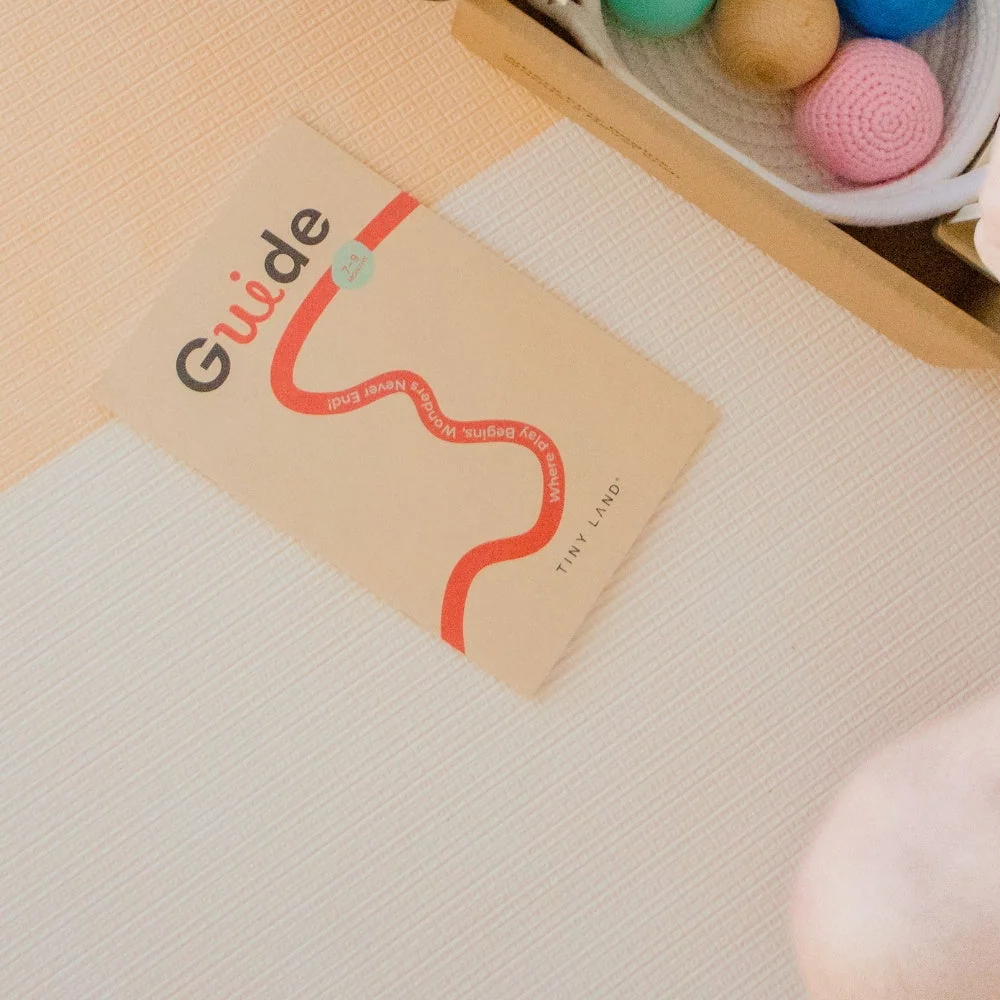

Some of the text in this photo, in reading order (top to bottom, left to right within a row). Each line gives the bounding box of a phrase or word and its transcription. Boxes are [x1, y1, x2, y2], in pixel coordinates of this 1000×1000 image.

[175, 207, 330, 393] Guide
[327, 391, 360, 411] End!
[364, 379, 406, 397] Never
[410, 381, 456, 439] Wonders
[462, 425, 515, 440] Begins,
[546, 452, 561, 503] Where
[555, 532, 587, 573] TINY
